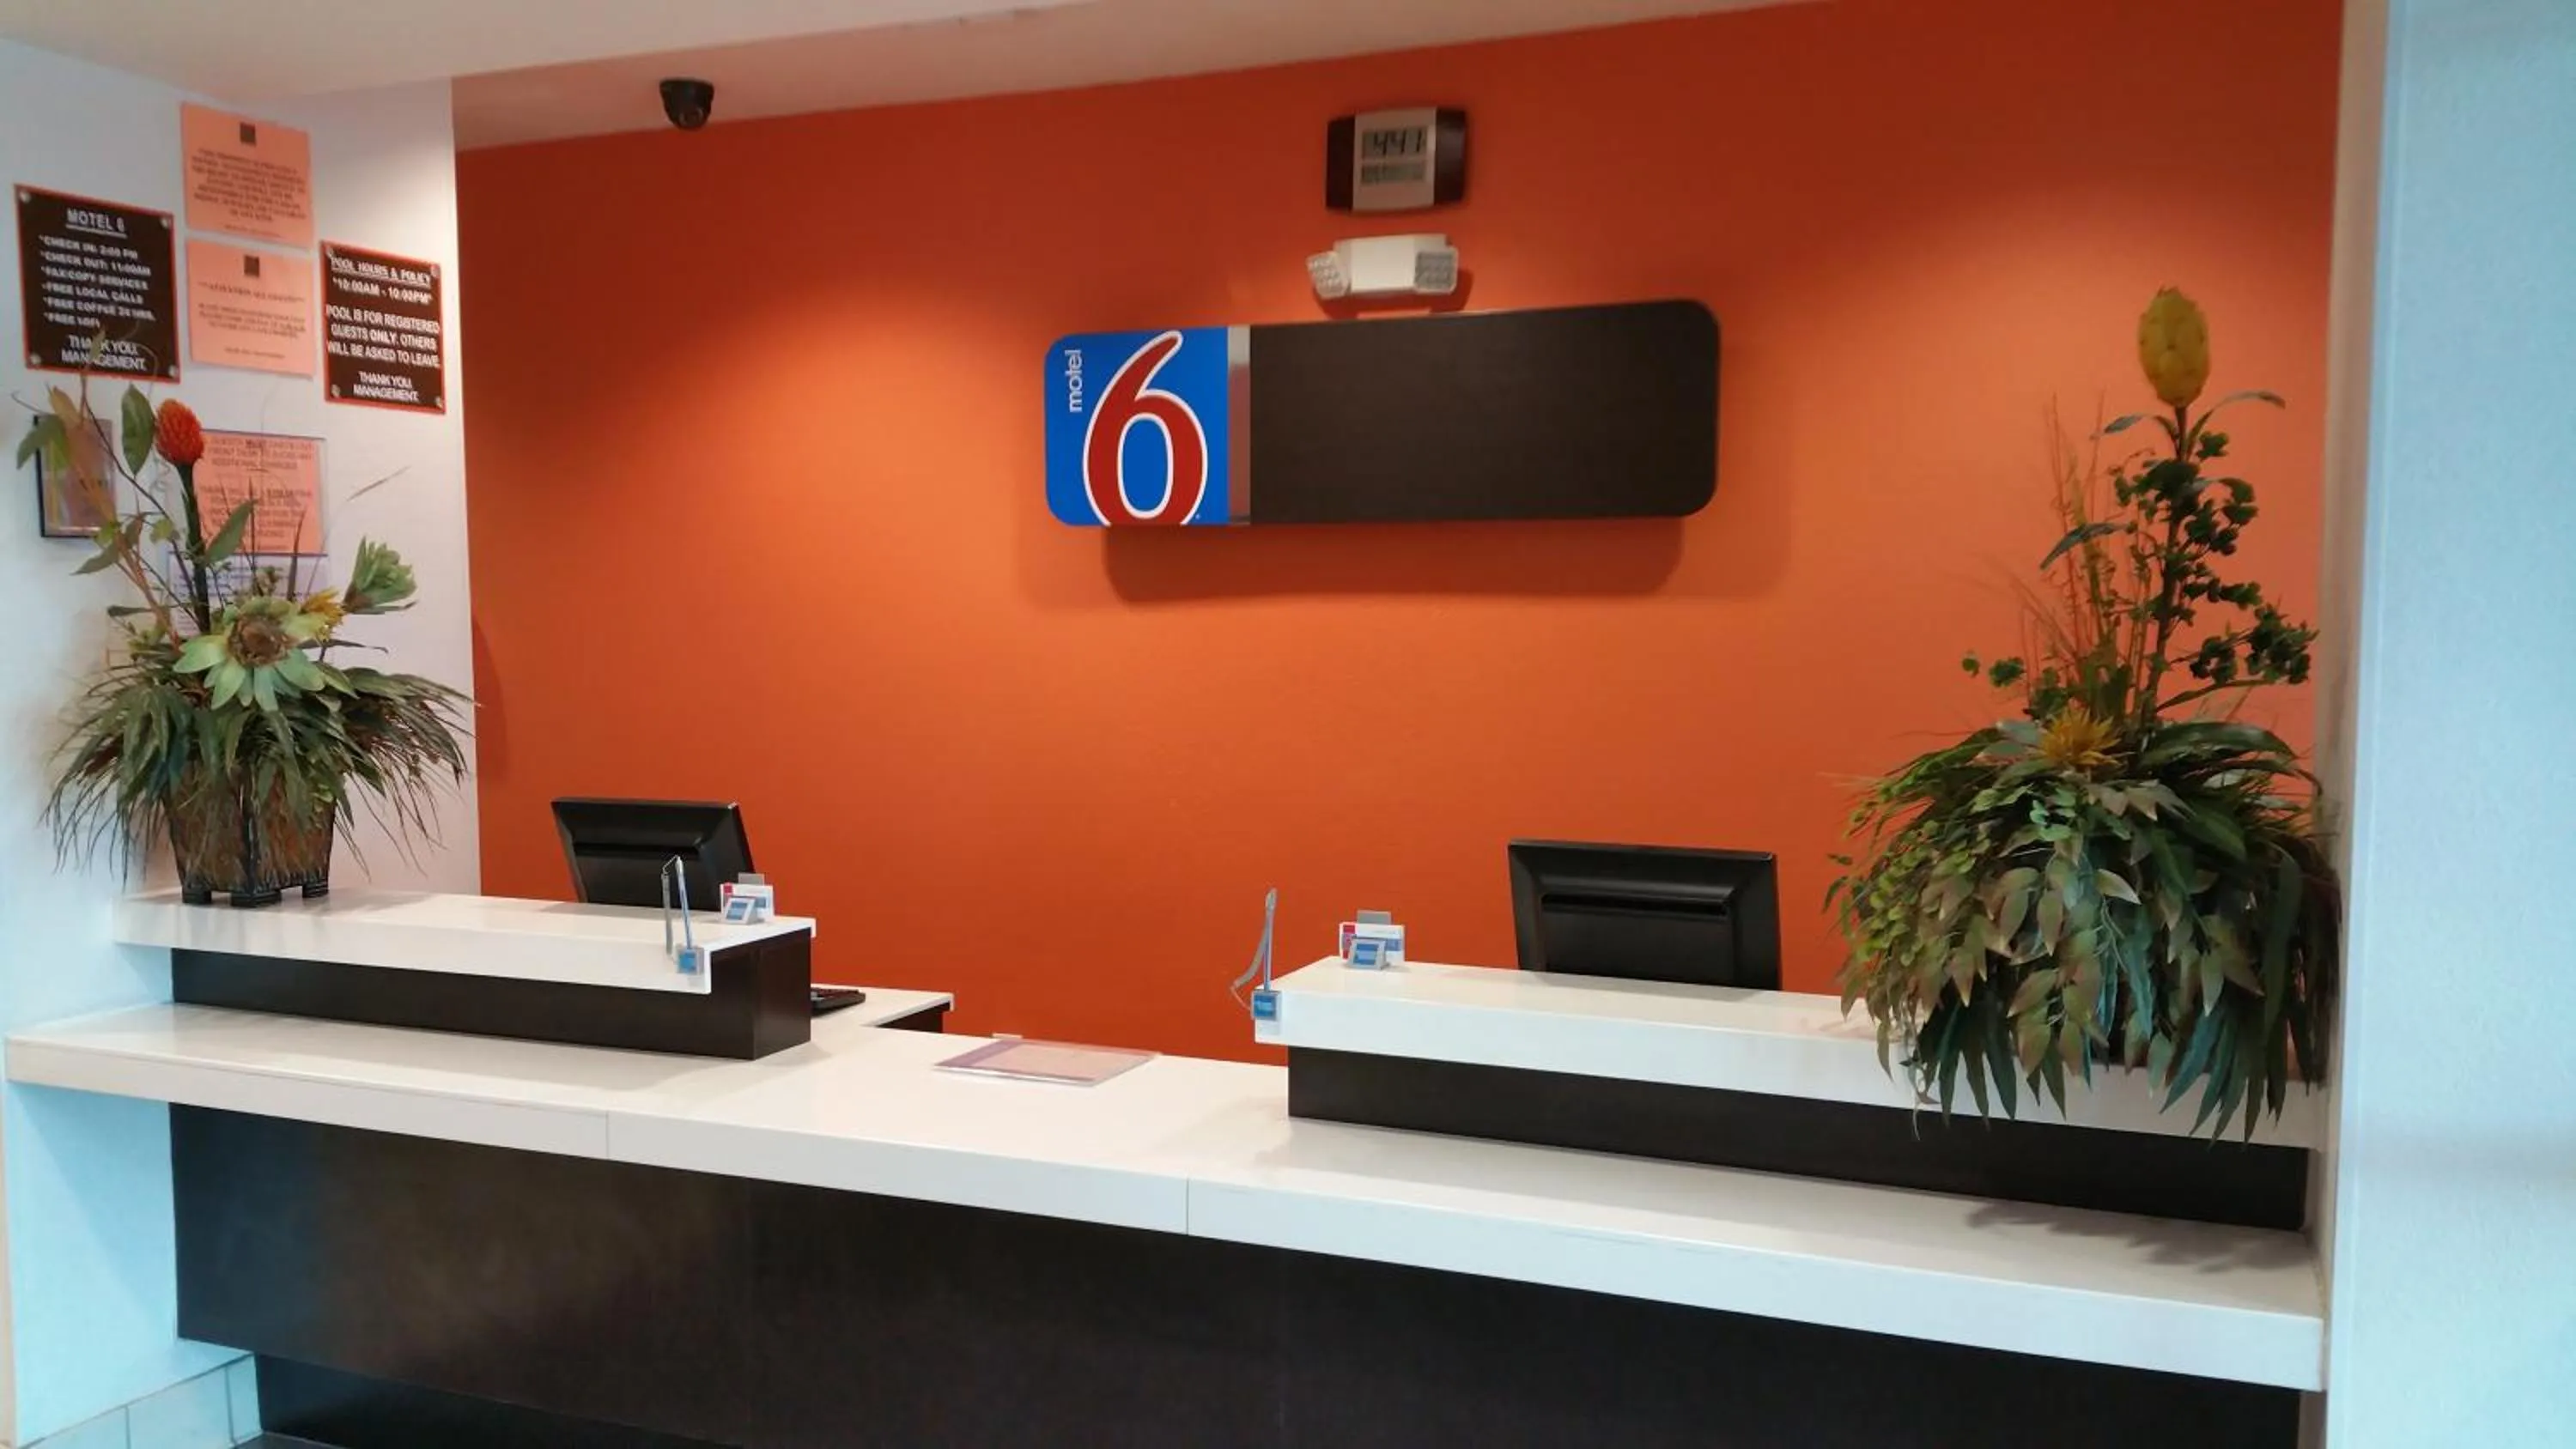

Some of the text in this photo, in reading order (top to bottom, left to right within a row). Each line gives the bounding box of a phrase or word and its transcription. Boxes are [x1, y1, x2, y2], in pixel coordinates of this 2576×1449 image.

[67, 209, 126, 233] MOTEL 6
[331, 258, 354, 271] POOL
[358, 261, 387, 277] HOURS
[326, 304, 352, 321] POOL
[364, 310, 382, 325] FOR
[385, 313, 440, 334] REGISTERED
[69, 335, 109, 354] THAK
[331, 324, 368, 341] GUESTS
[400, 334, 437, 352] OTHERS
[328, 341, 349, 356] WILL
[350, 344, 363, 357] BE
[365, 347, 396, 361] ASKED
[397, 350, 410, 363] TO
[359, 371, 390, 385] THANK
[1065, 349, 1083, 413] motel
[1083, 330, 1208, 526] 6
